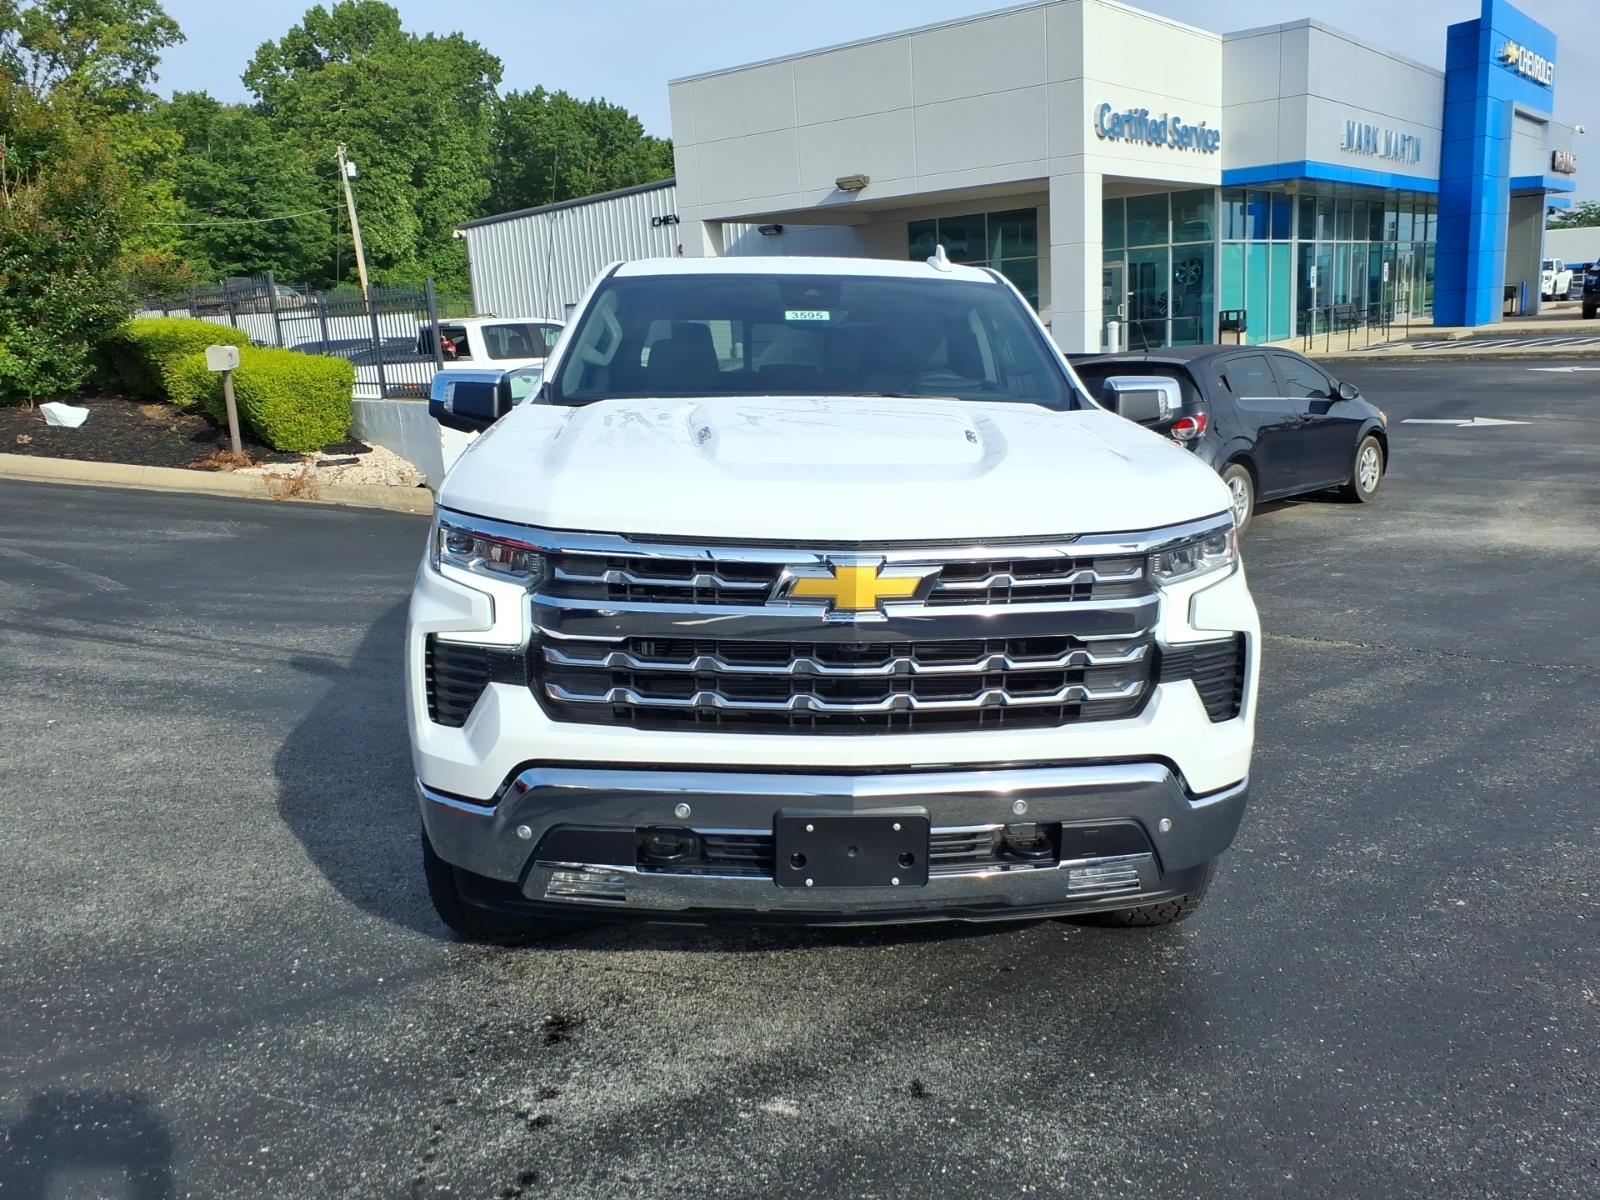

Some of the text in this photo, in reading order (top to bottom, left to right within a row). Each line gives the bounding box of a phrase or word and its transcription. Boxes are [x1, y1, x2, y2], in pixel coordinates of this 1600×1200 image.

[1094, 102, 1220, 154] Certified Service
[1344, 119, 1421, 163] MARK MARTIN
